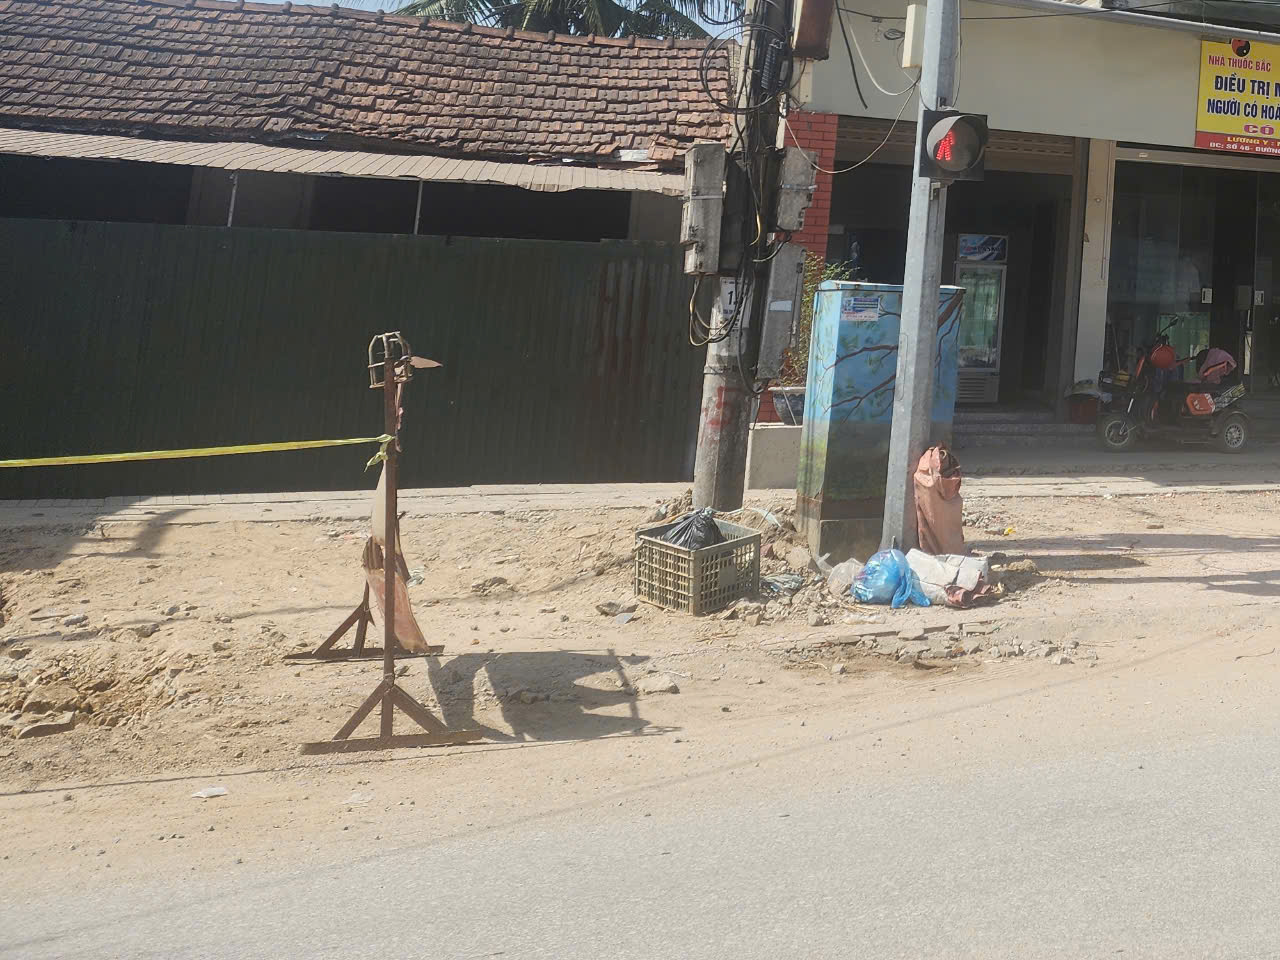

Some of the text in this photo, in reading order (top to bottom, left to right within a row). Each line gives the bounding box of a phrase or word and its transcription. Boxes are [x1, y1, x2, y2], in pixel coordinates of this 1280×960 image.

[1215, 72, 1246, 93] ĐIỀU
[1250, 80, 1270, 99] TRỊ
[1207, 98, 1240, 117] NGƯỜI
[1243, 101, 1258, 118] CÓ
